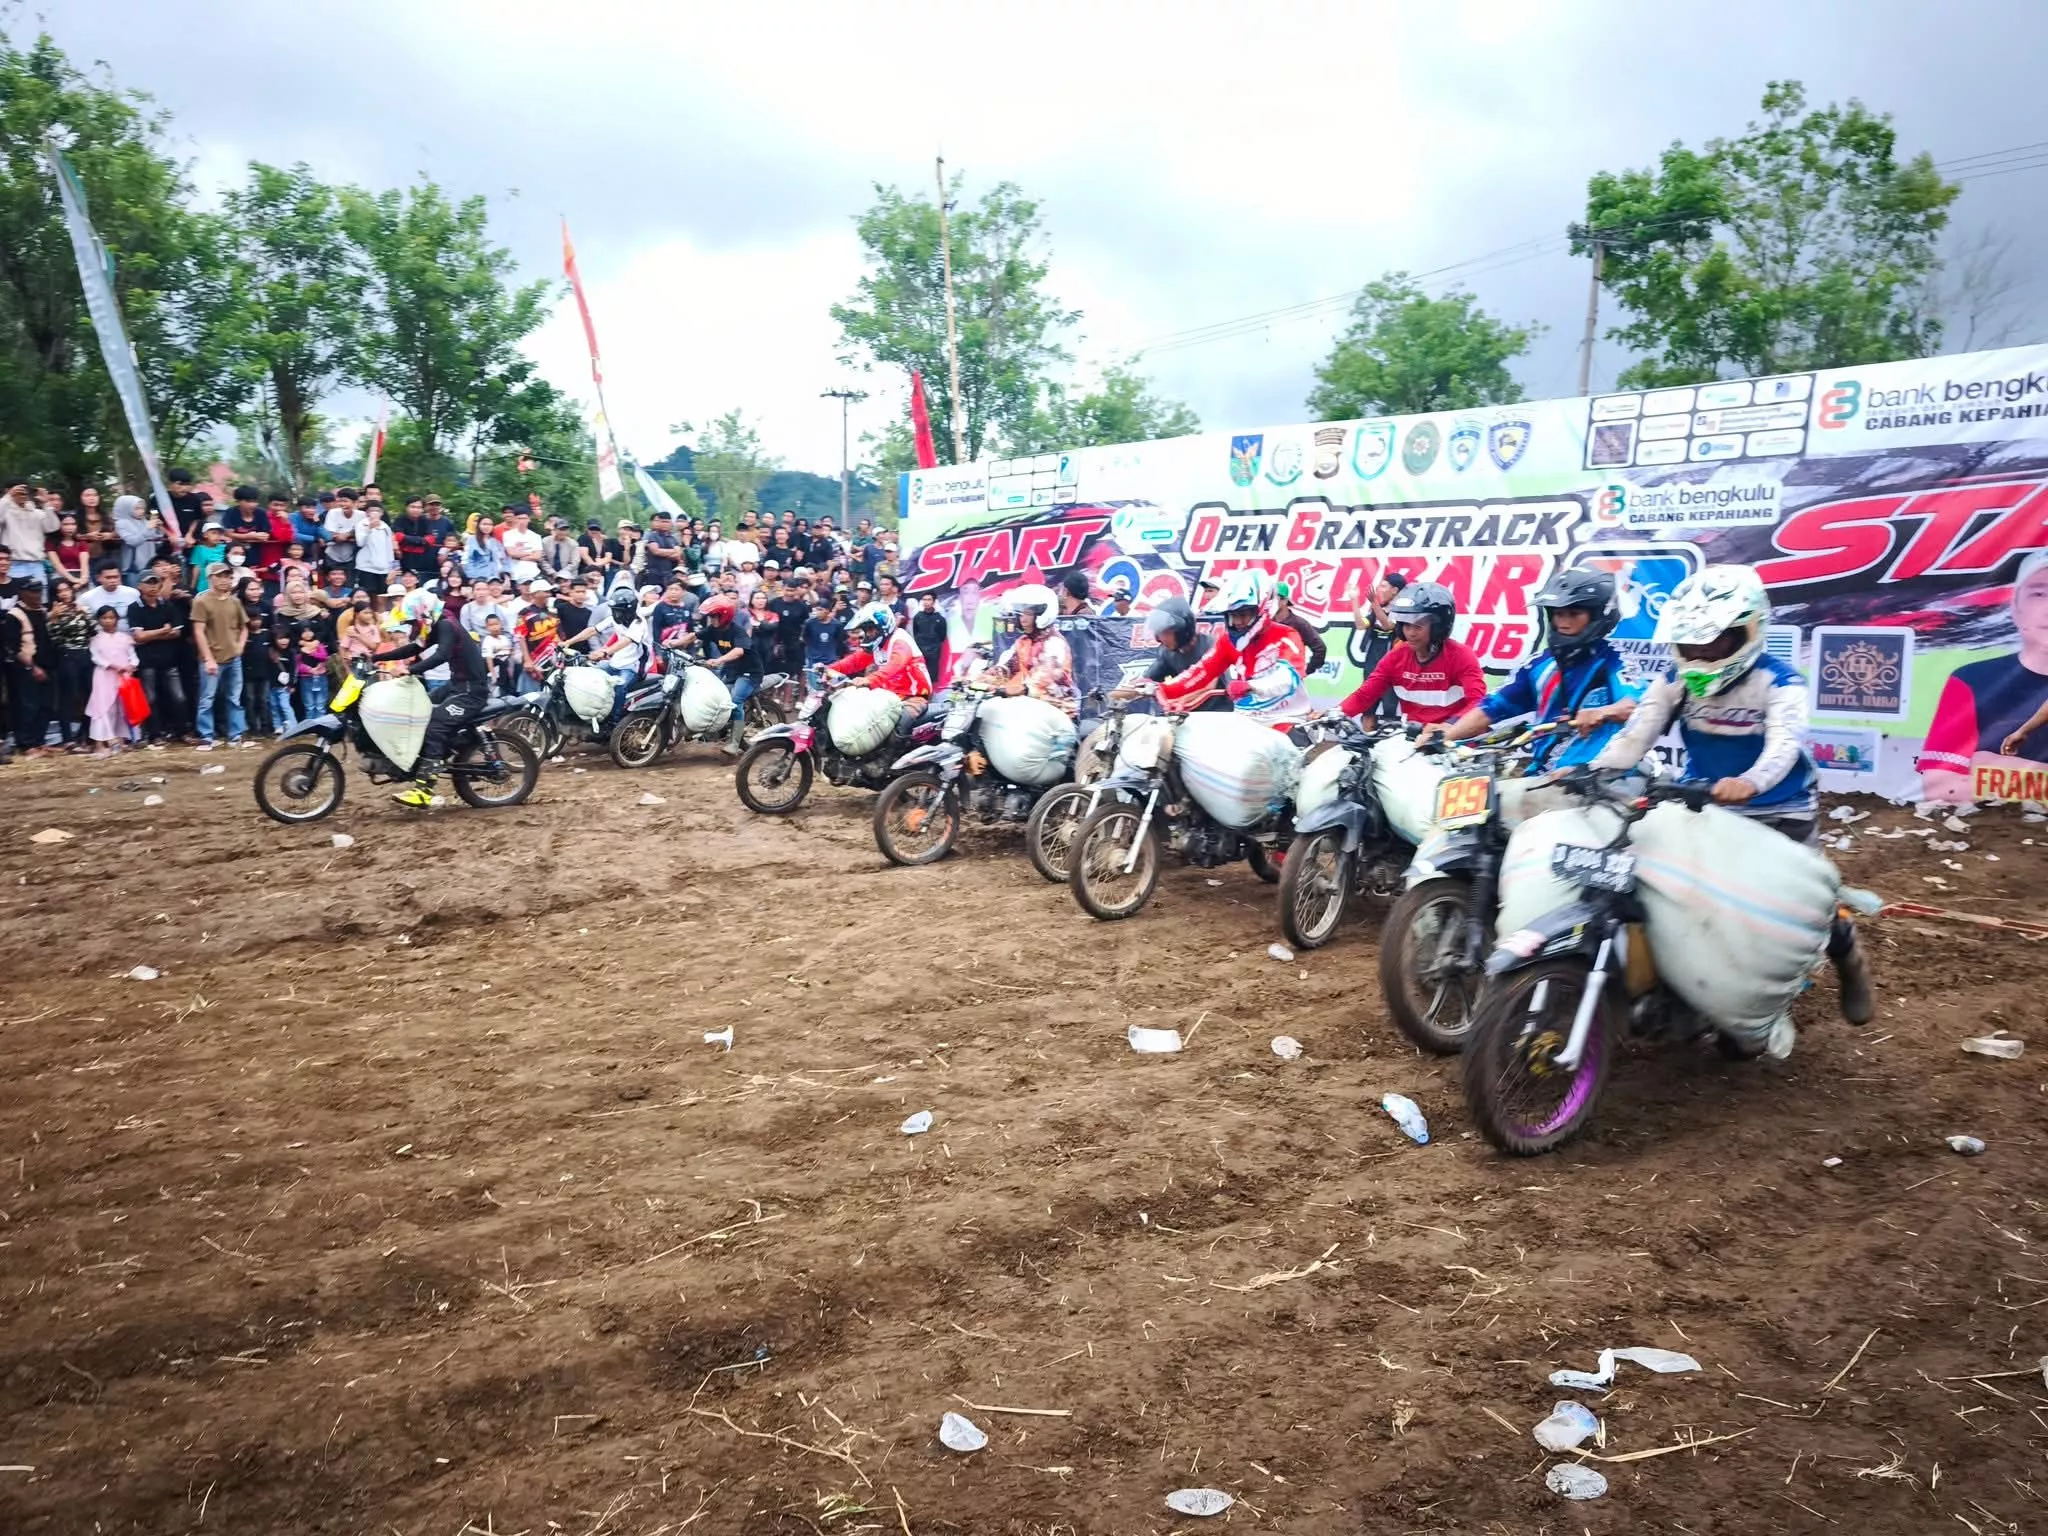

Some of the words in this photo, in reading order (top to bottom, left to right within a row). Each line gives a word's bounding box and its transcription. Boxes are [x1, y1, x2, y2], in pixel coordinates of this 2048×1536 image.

[1867, 382, 1936, 409] bank
[1943, 370, 2048, 402] bengk
[1864, 410, 1953, 431] CABANG
[1629, 488, 1675, 507] bank
[1679, 483, 1775, 508] bengkulu
[1628, 511, 1685, 524] CABANG
[1688, 507, 1773, 522] KEPAHIANG
[905, 519, 1107, 592] START
[1975, 767, 2048, 801] FRAN
